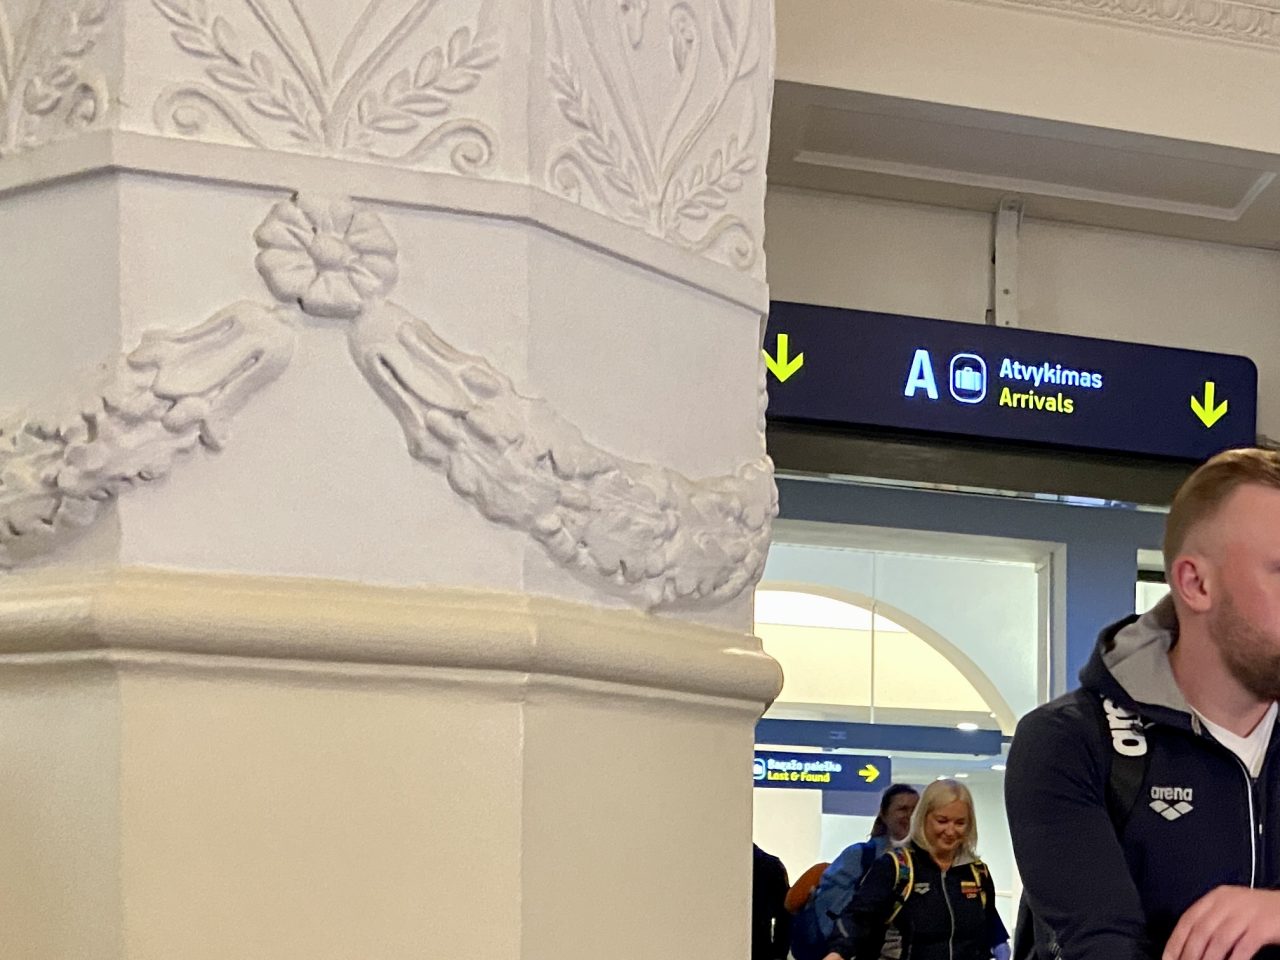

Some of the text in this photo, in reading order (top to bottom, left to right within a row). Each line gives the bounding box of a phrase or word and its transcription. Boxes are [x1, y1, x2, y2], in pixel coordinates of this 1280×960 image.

[904, 348, 1103, 400] A Atvykimas
[999, 386, 1074, 414] Arrivals
[767, 770, 790, 781] Lost
[800, 771, 831, 783] Found
[1150, 786, 1193, 801] arena
